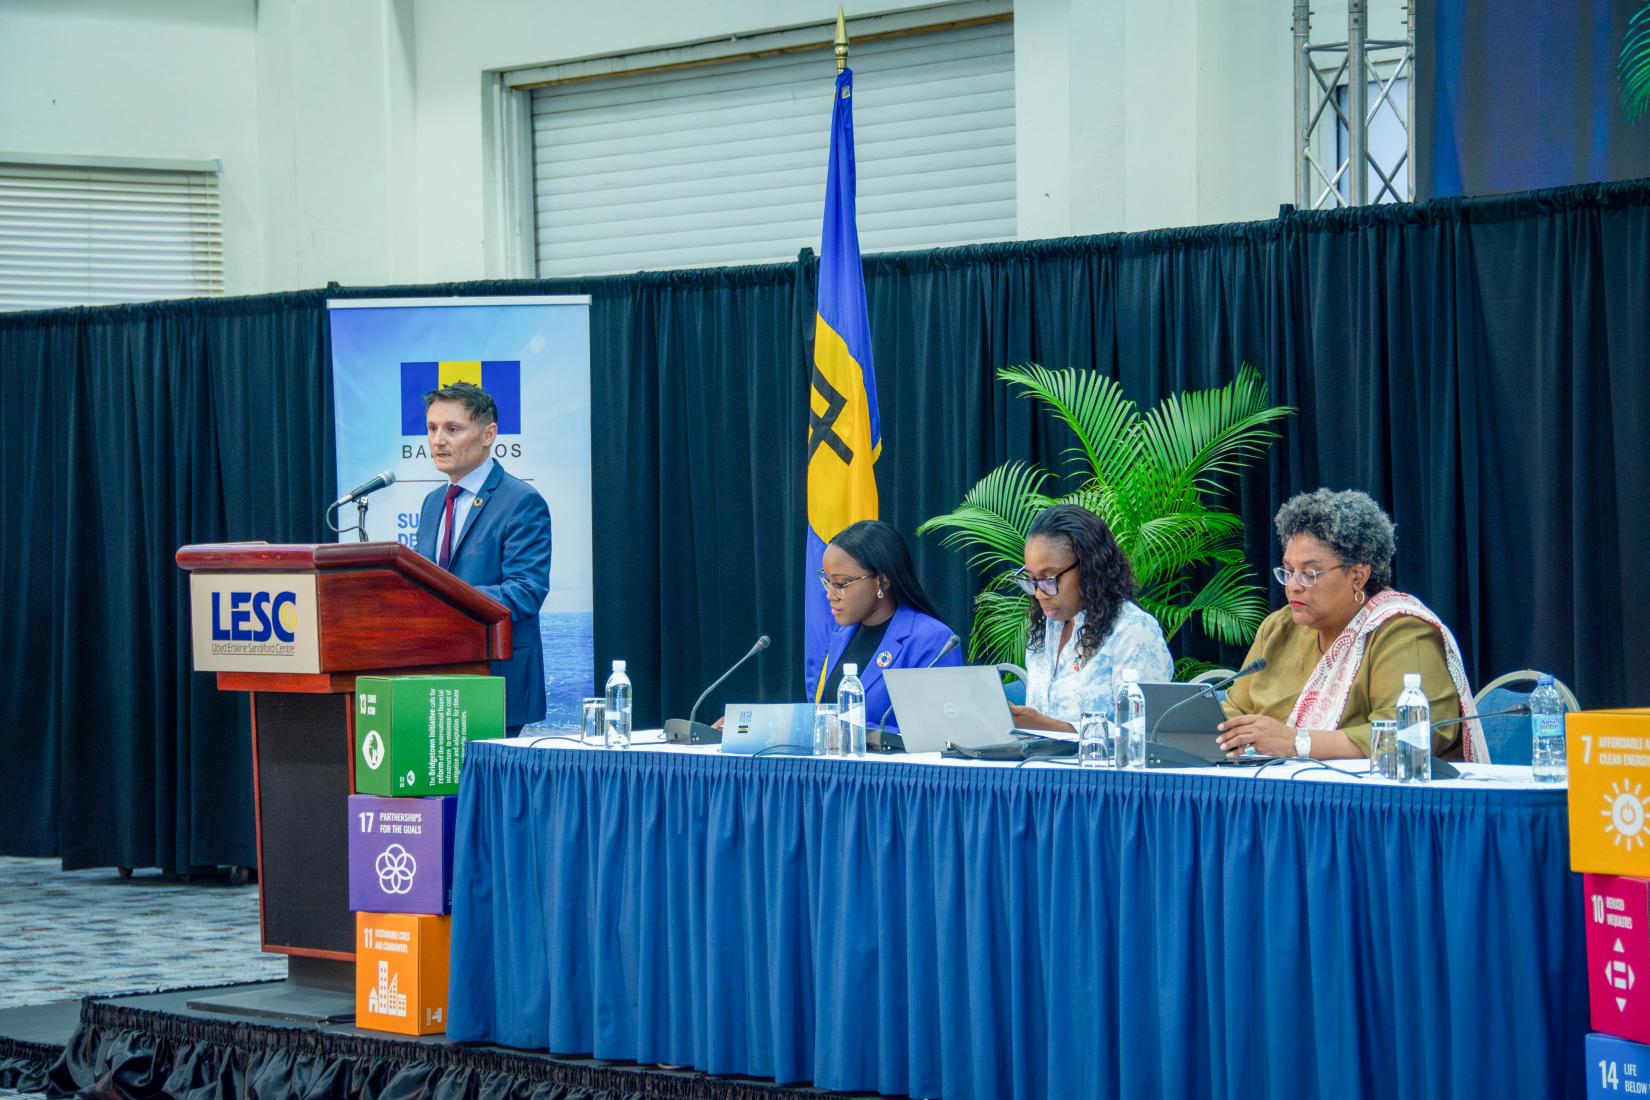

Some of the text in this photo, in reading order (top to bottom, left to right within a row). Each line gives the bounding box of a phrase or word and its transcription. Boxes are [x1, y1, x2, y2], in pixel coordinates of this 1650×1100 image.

[402, 444, 522, 459] BAOS
[212, 591, 297, 643] LESC
[212, 642, 227, 654] Lloyd
[228, 643, 248, 653] Erskine
[276, 643, 295, 654] Centre
[428, 709, 436, 738] Initiative
[428, 739, 438, 776] Bridgetown
[1581, 735, 1592, 764] 7
[1599, 736, 1643, 750] AFFORDABLE
[1600, 752, 1623, 766] CLEAN
[359, 812, 422, 833] 17 PARTNERSHIPS
[380, 824, 422, 835] FOR THE GOALS
[1591, 894, 1605, 924] 10
[364, 927, 373, 949] 11
[1599, 1060, 1637, 1091] 14 LIFE
[1625, 1080, 1648, 1095] BELOW
